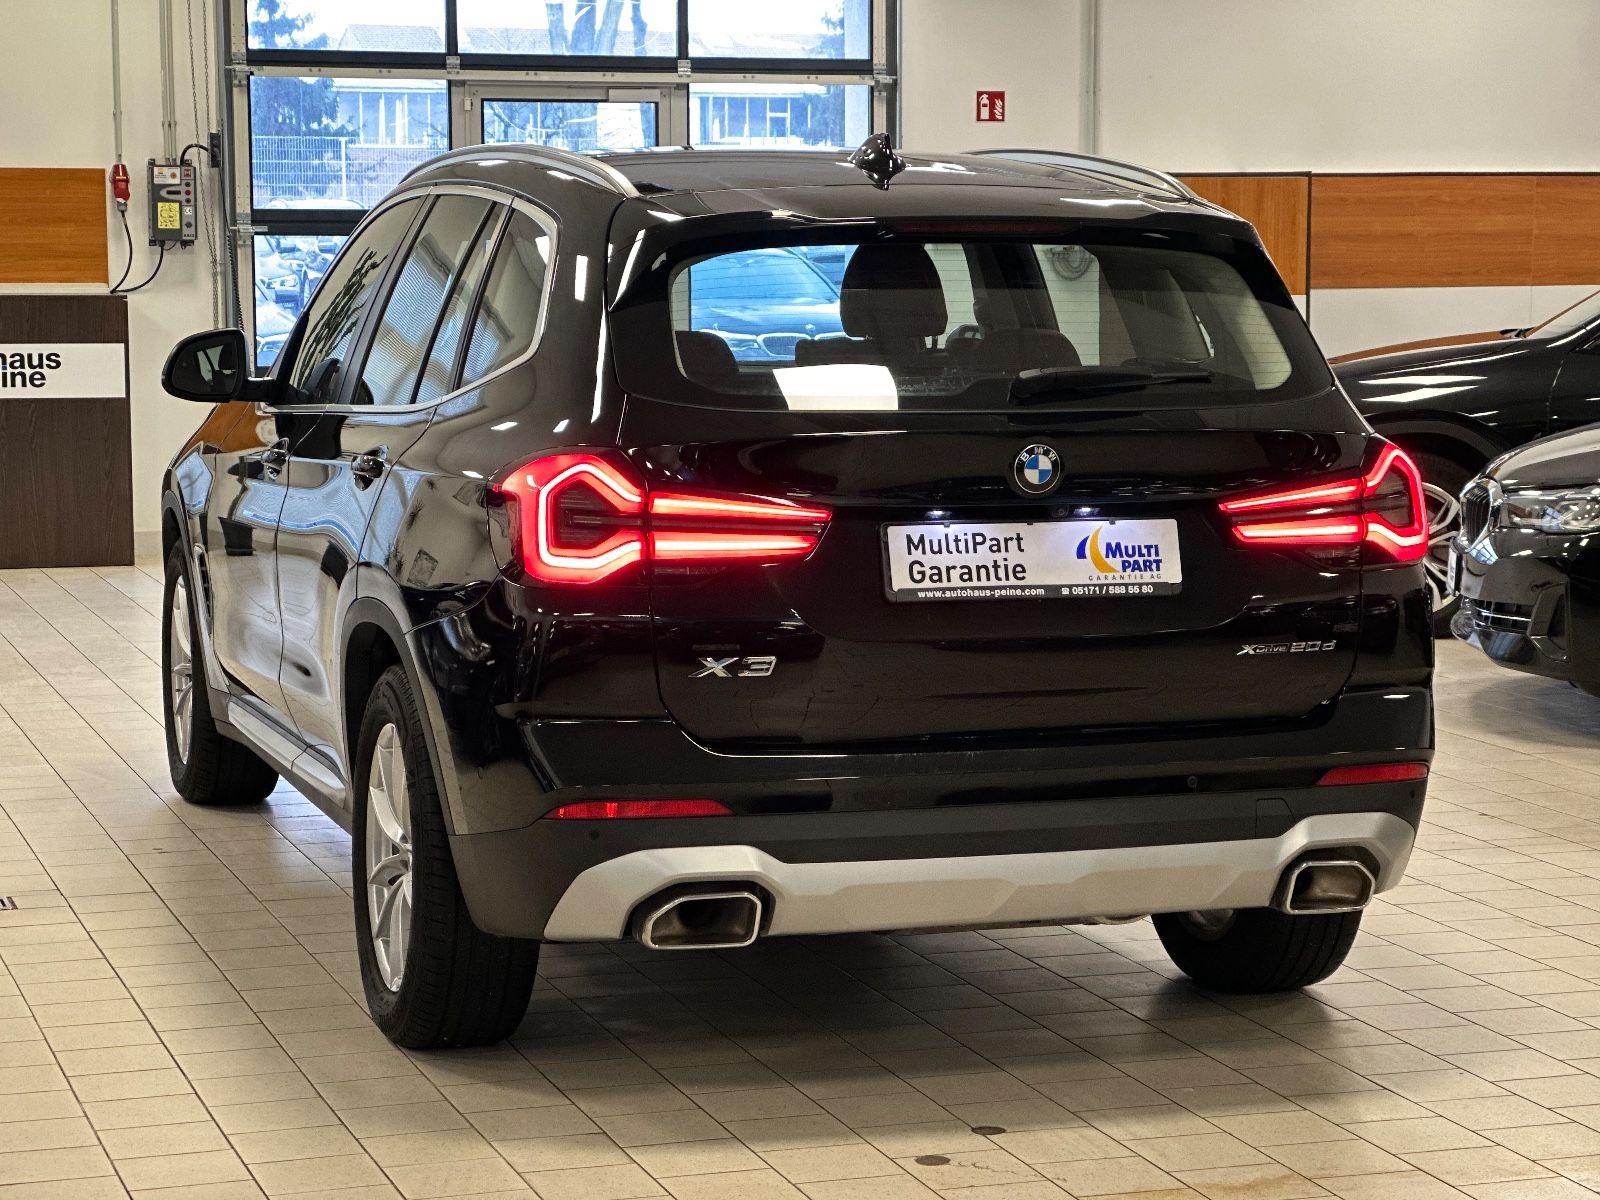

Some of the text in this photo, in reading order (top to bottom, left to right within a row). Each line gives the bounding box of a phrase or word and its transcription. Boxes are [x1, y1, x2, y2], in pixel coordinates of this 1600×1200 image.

[1020, 446, 1057, 462] BMW
[905, 532, 1025, 556] MultiPart
[1104, 541, 1160, 558] MULTI
[908, 557, 1027, 584] Garantie
[1121, 558, 1162, 573] PART
[1088, 573, 1144, 581] GARANTIE
[917, 587, 1045, 598] www.autohaus-peine.com
[1072, 586, 1100, 595] 05171
[1108, 585, 1126, 594] 588
[1128, 585, 1140, 593] 55
[1142, 584, 1154, 593] 80
[688, 656, 777, 677] X3
